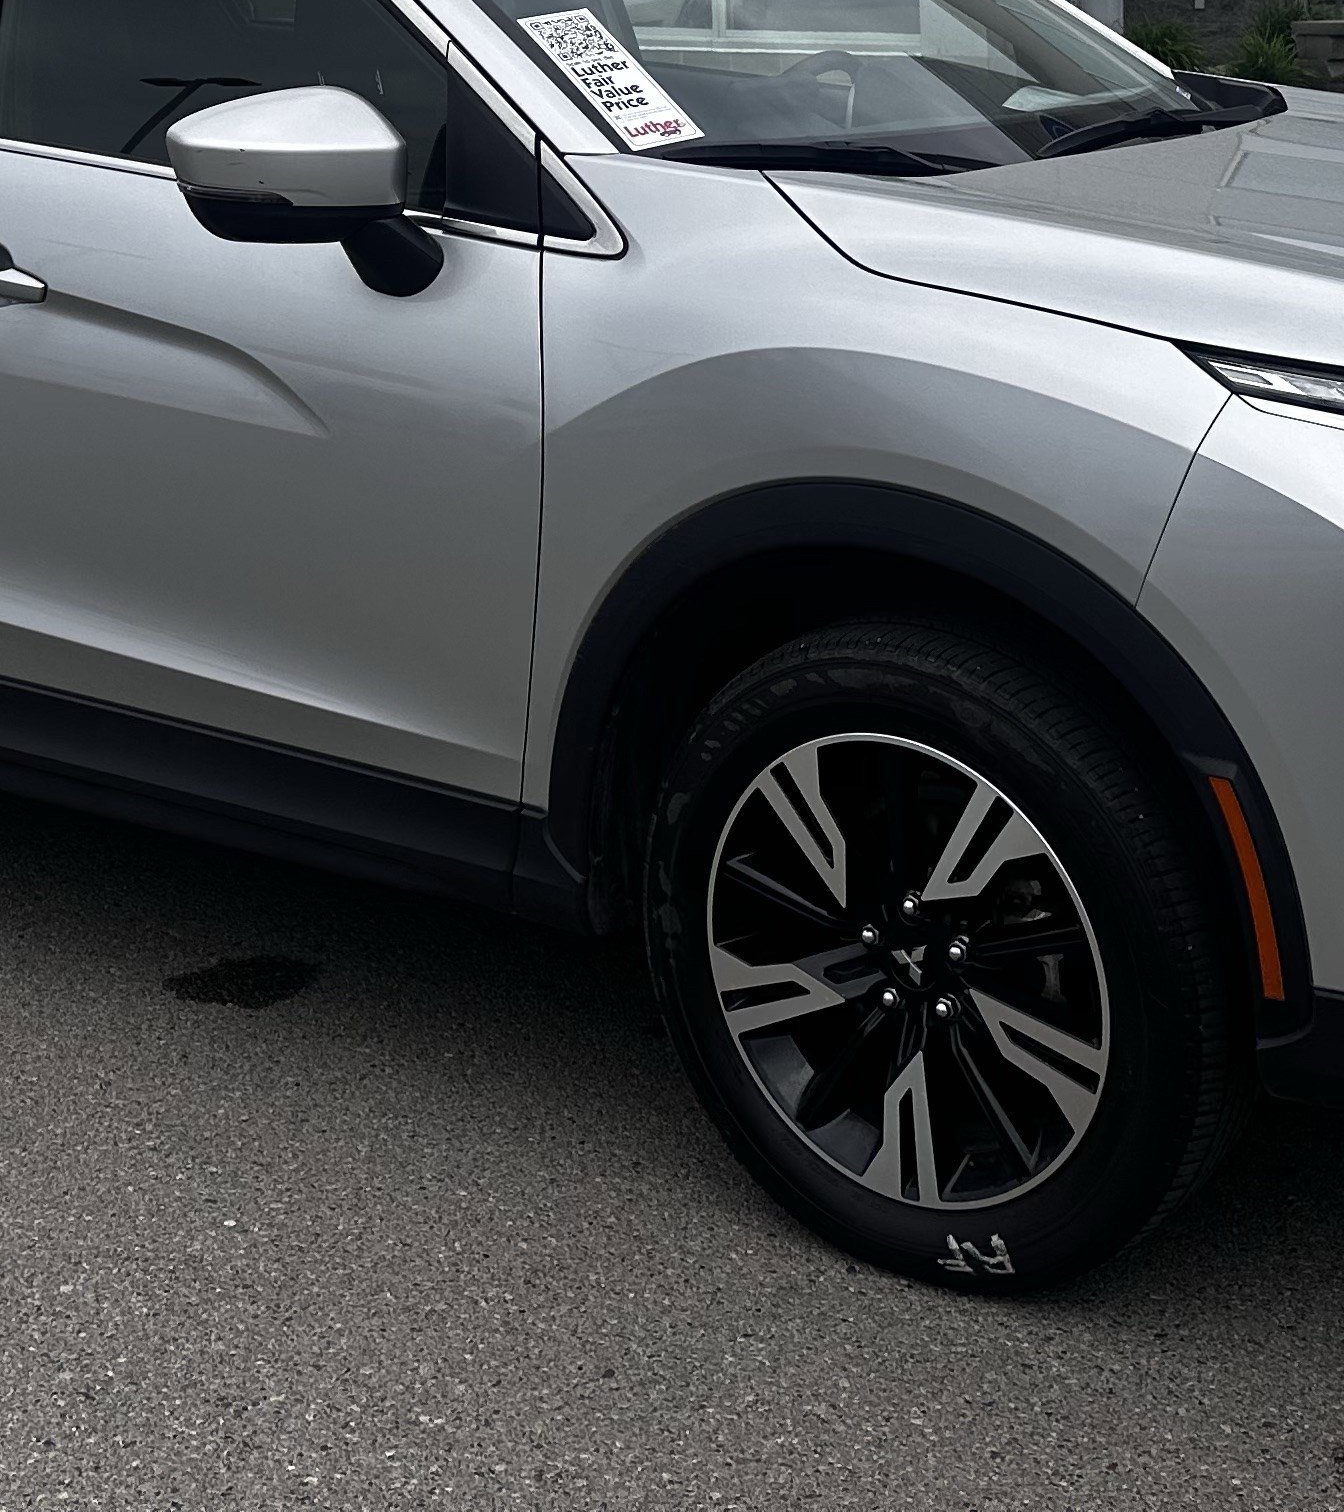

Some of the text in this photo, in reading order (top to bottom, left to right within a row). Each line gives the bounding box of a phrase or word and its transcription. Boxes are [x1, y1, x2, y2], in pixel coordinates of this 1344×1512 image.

[571, 61, 630, 77] Luther
[581, 75, 615, 89] Fair
[590, 84, 643, 99] Value
[601, 97, 649, 112] Price
[624, 119, 680, 138] Luther
